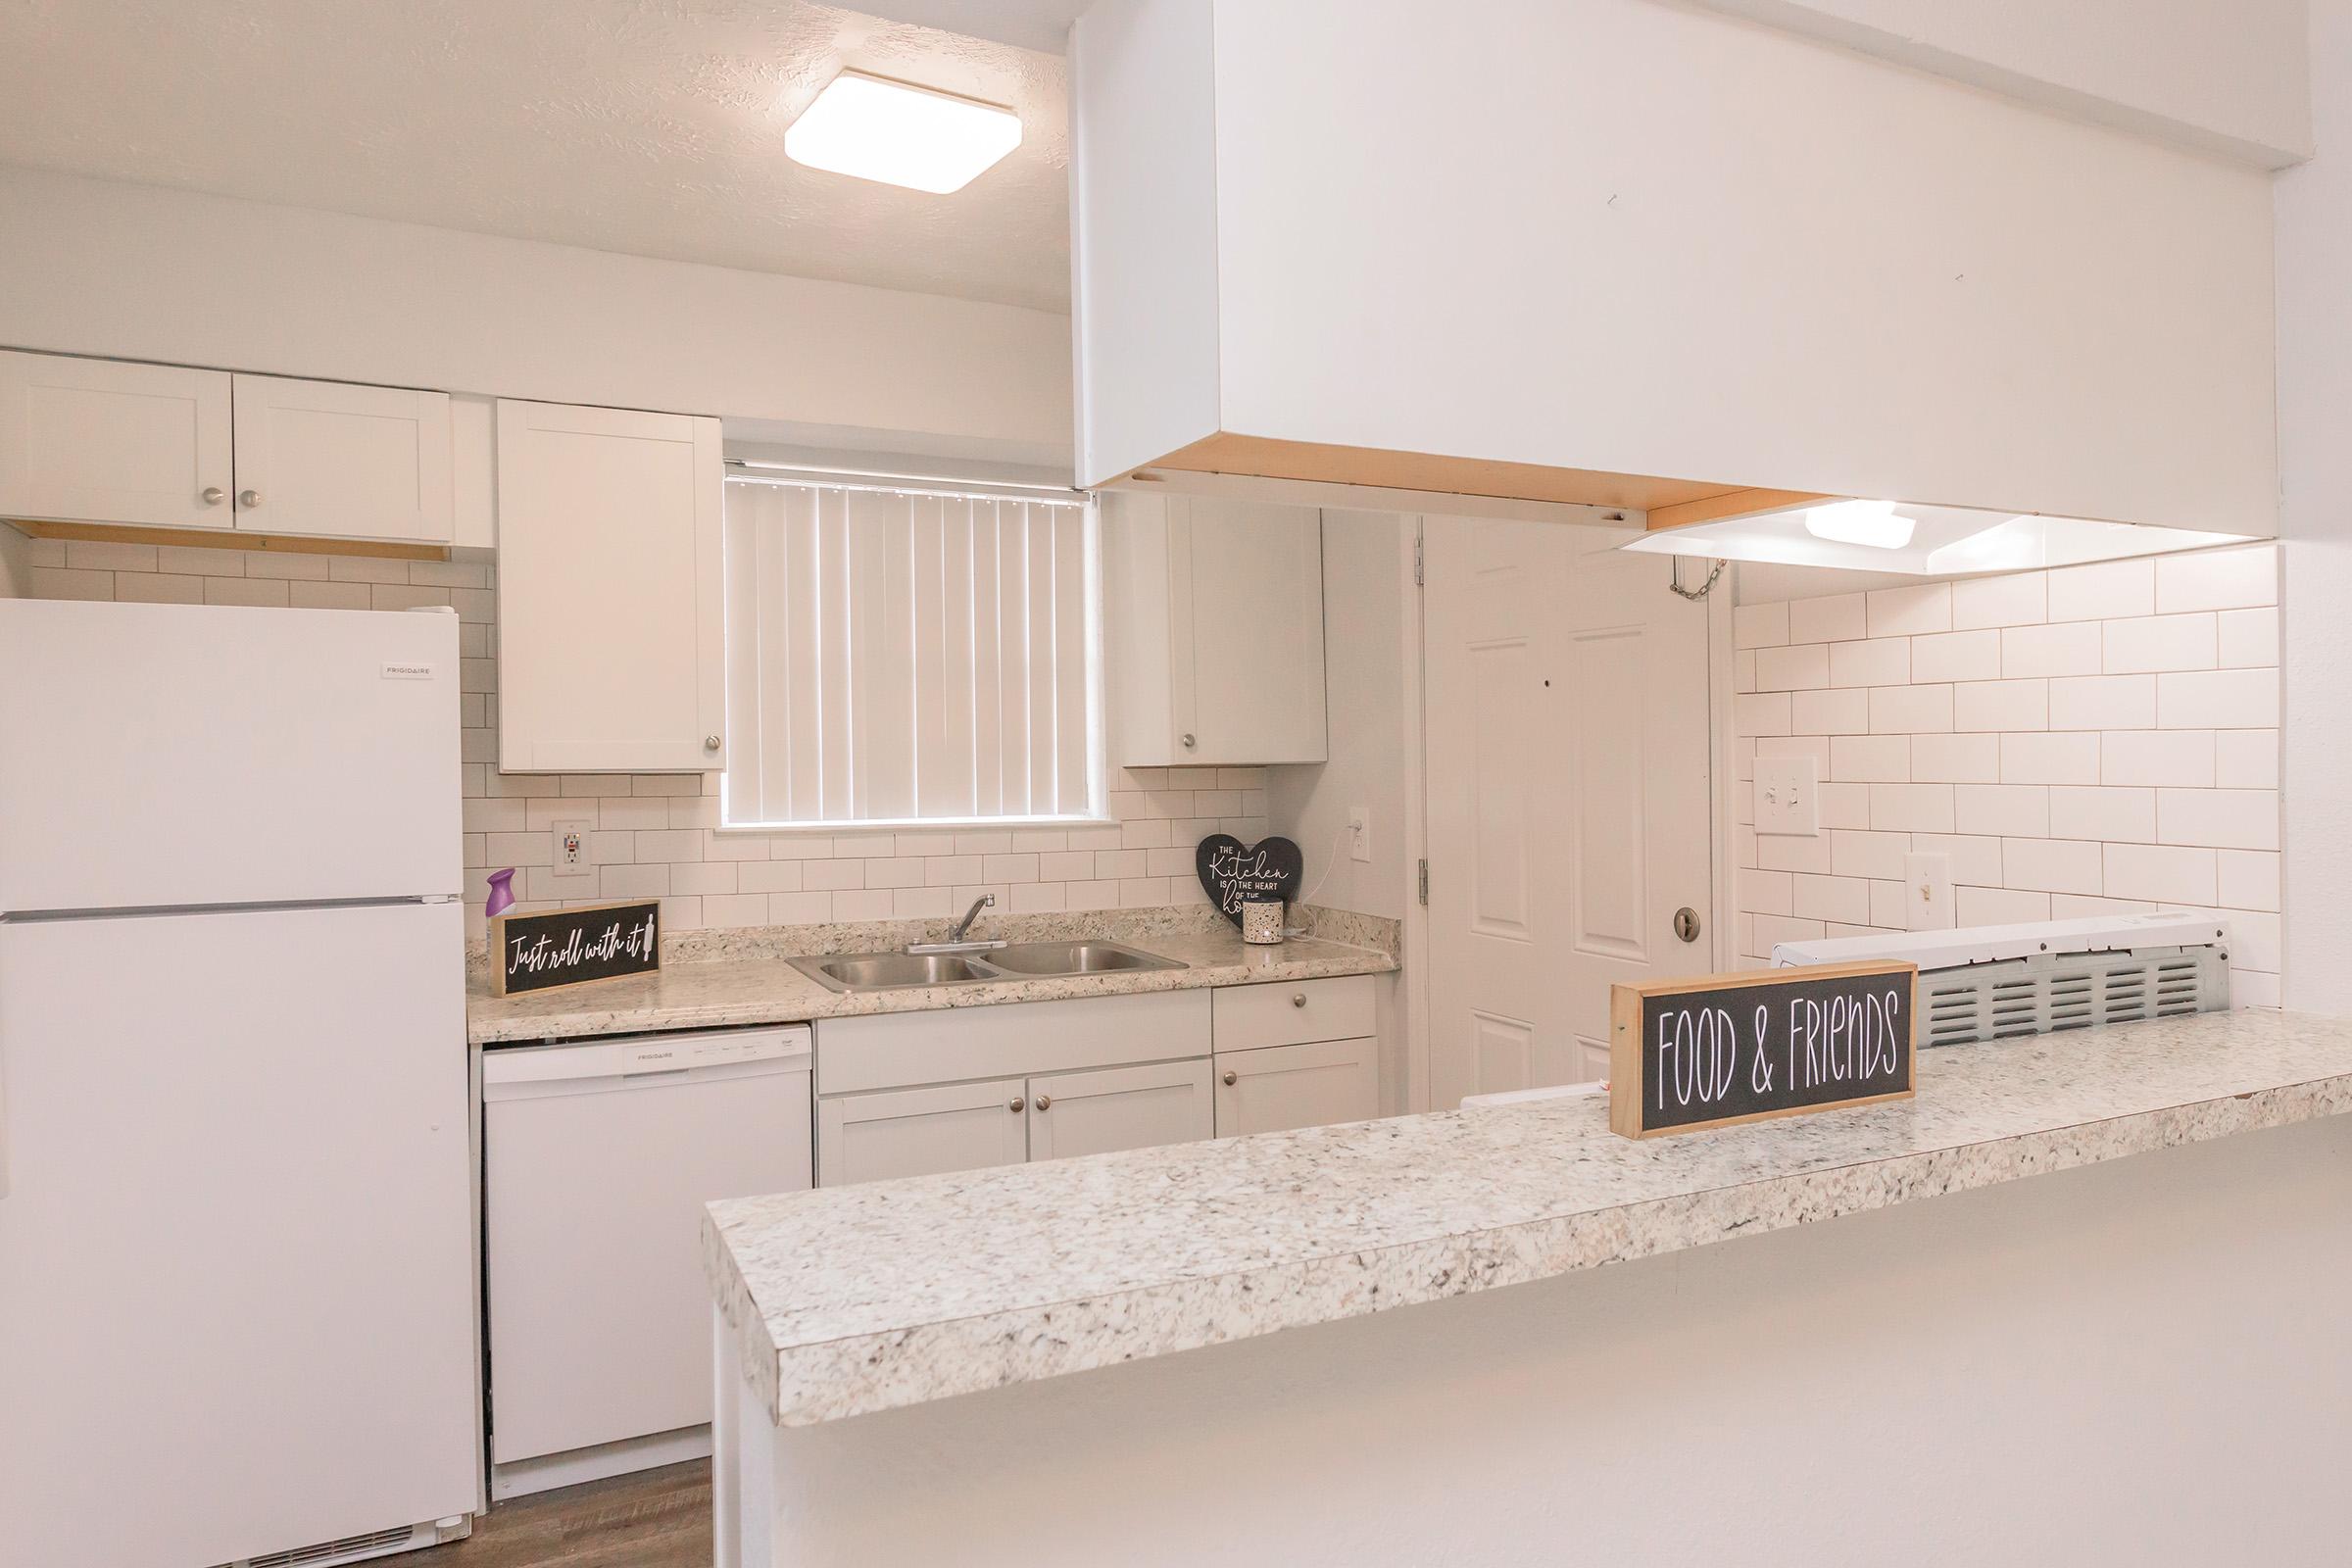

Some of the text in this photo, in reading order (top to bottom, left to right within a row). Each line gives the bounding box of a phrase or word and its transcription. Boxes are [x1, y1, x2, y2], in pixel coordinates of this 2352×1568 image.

[1209, 851, 1289, 879] Kitchen
[509, 922, 645, 974] Just roll with it
[1658, 1007, 1736, 1109] FOOD
[1751, 1004, 1774, 1094] &
